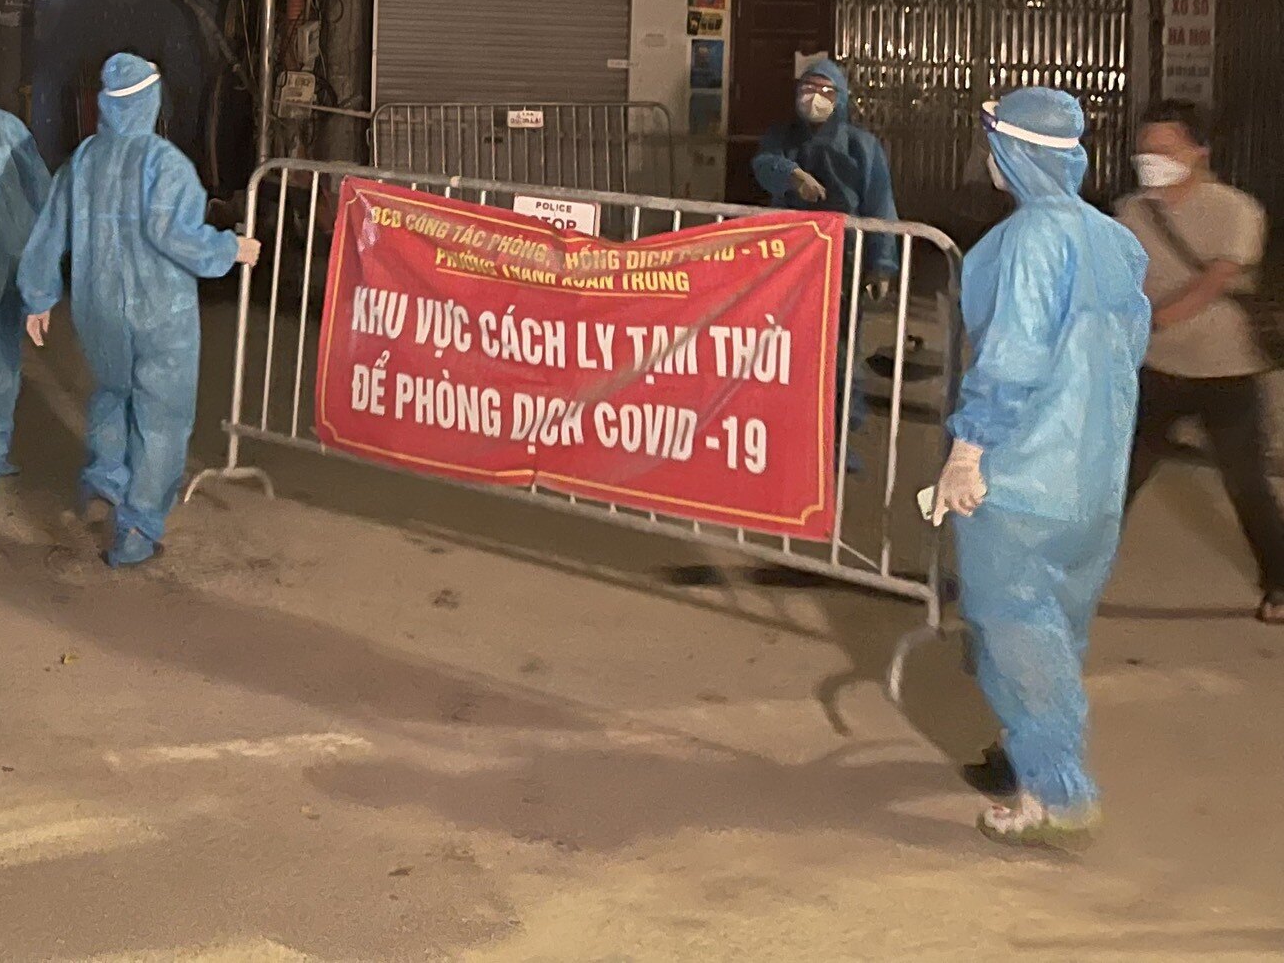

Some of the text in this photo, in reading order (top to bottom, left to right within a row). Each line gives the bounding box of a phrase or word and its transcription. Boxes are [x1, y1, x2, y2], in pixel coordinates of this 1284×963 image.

[536, 201, 572, 214] POLICE
[528, 215, 577, 230] TOP
[564, 244, 620, 270] HỐNG
[757, 239, 786, 259] 19
[622, 270, 690, 292] TRUNG
[351, 285, 791, 386] KHU VỰC CÁCH LY TẠM THỜI
[351, 350, 391, 417] ĐỂ
[395, 368, 502, 438] PHÒNG
[510, 392, 585, 455] DỊCH
[593, 401, 698, 462] COVID
